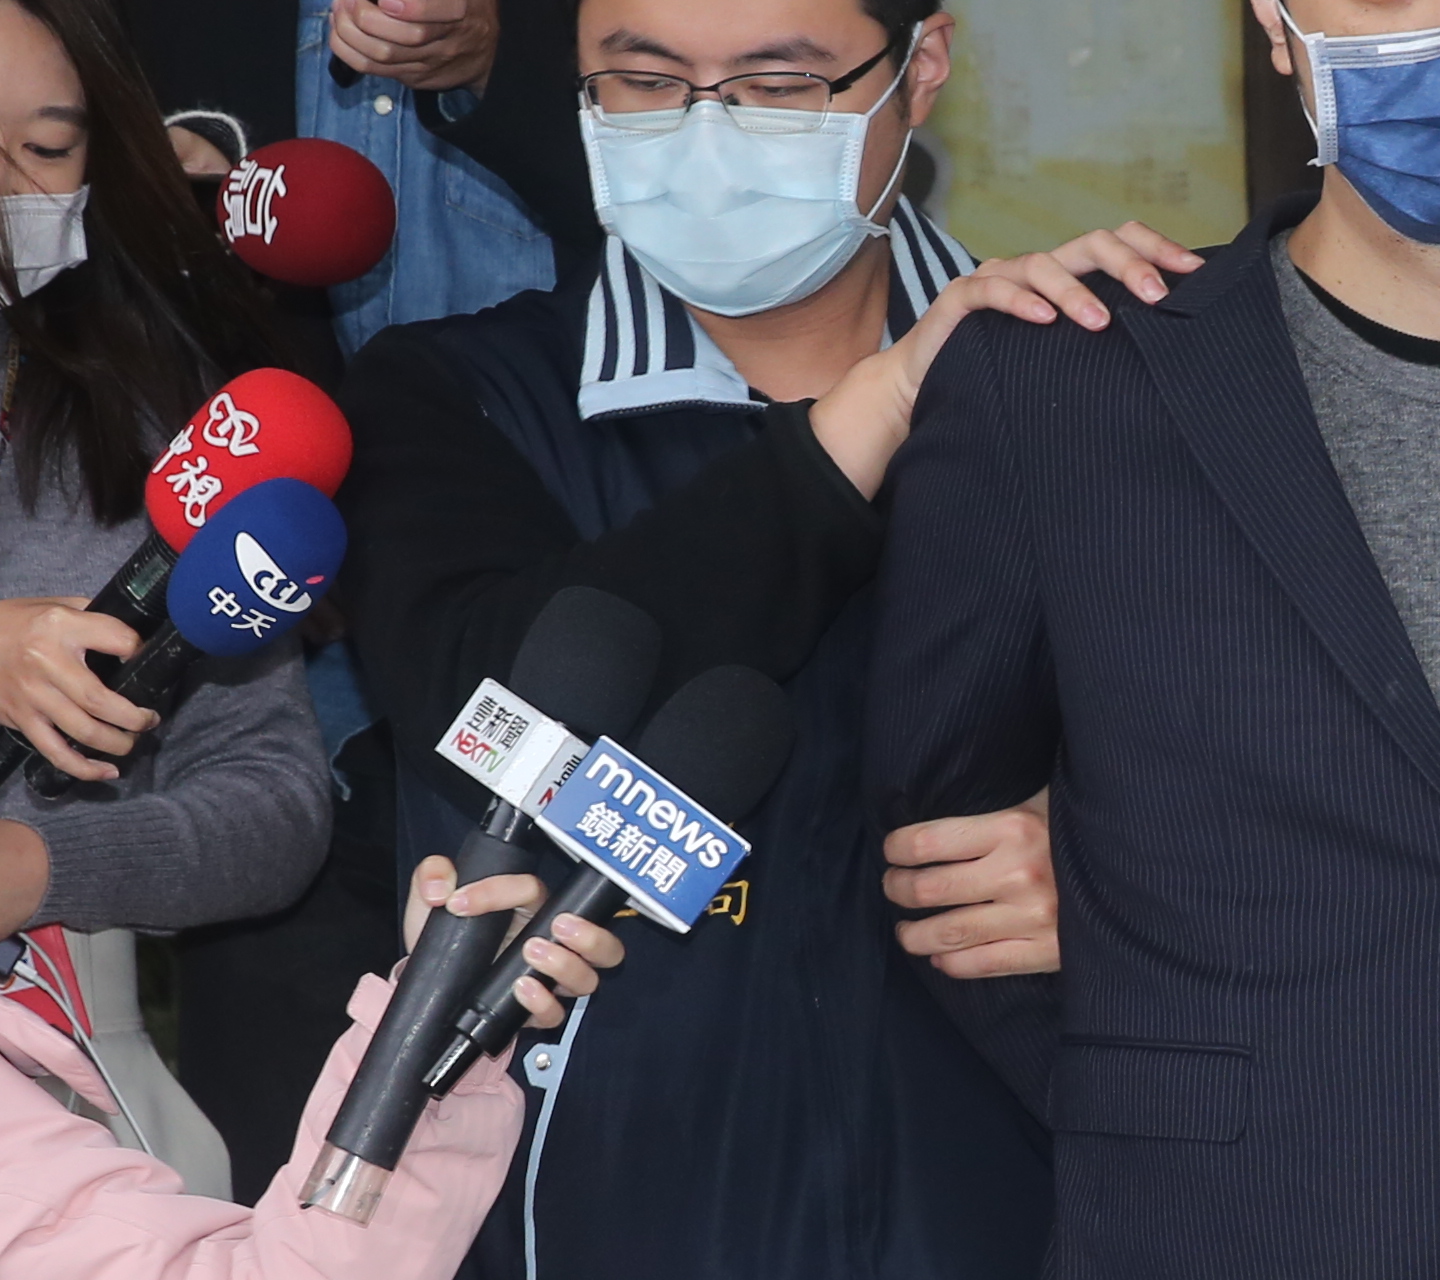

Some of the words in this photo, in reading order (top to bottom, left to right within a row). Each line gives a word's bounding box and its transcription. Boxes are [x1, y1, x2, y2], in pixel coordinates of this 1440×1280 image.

[223, 158, 287, 245] 台視
[152, 423, 224, 528] 中視
[207, 586, 277, 638] 中天
[465, 694, 530, 753] 壹新聞
[575, 800, 688, 894] 鏡新聞
[584, 751, 729, 870] mnews
